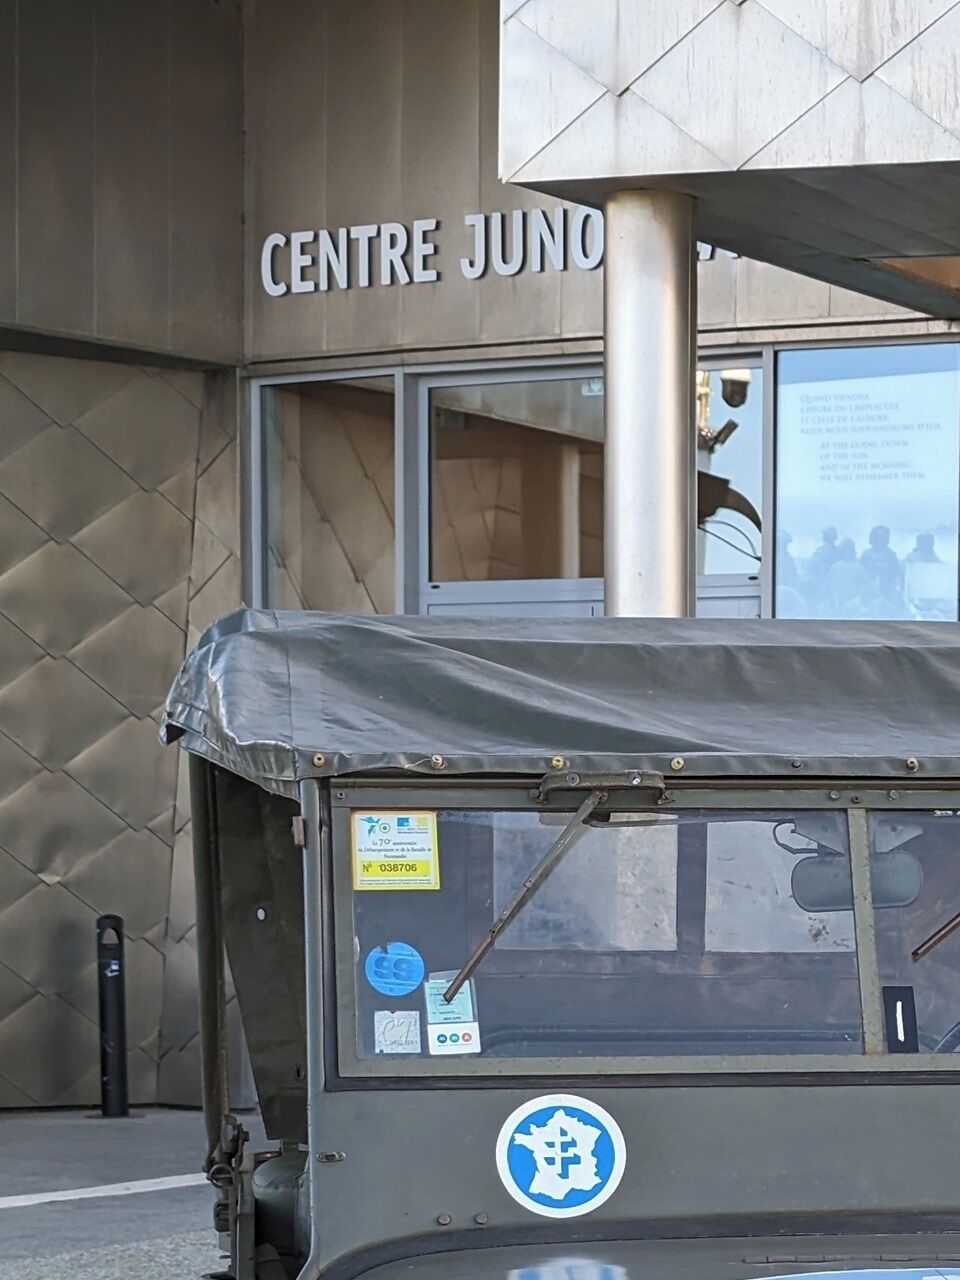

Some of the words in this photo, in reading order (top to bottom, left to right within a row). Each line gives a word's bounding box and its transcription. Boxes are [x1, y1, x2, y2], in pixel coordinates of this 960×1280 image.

[260, 219, 439, 297] CENTRE
[460, 206, 605, 281] JUNO
[379, 863, 418, 873] 038706
